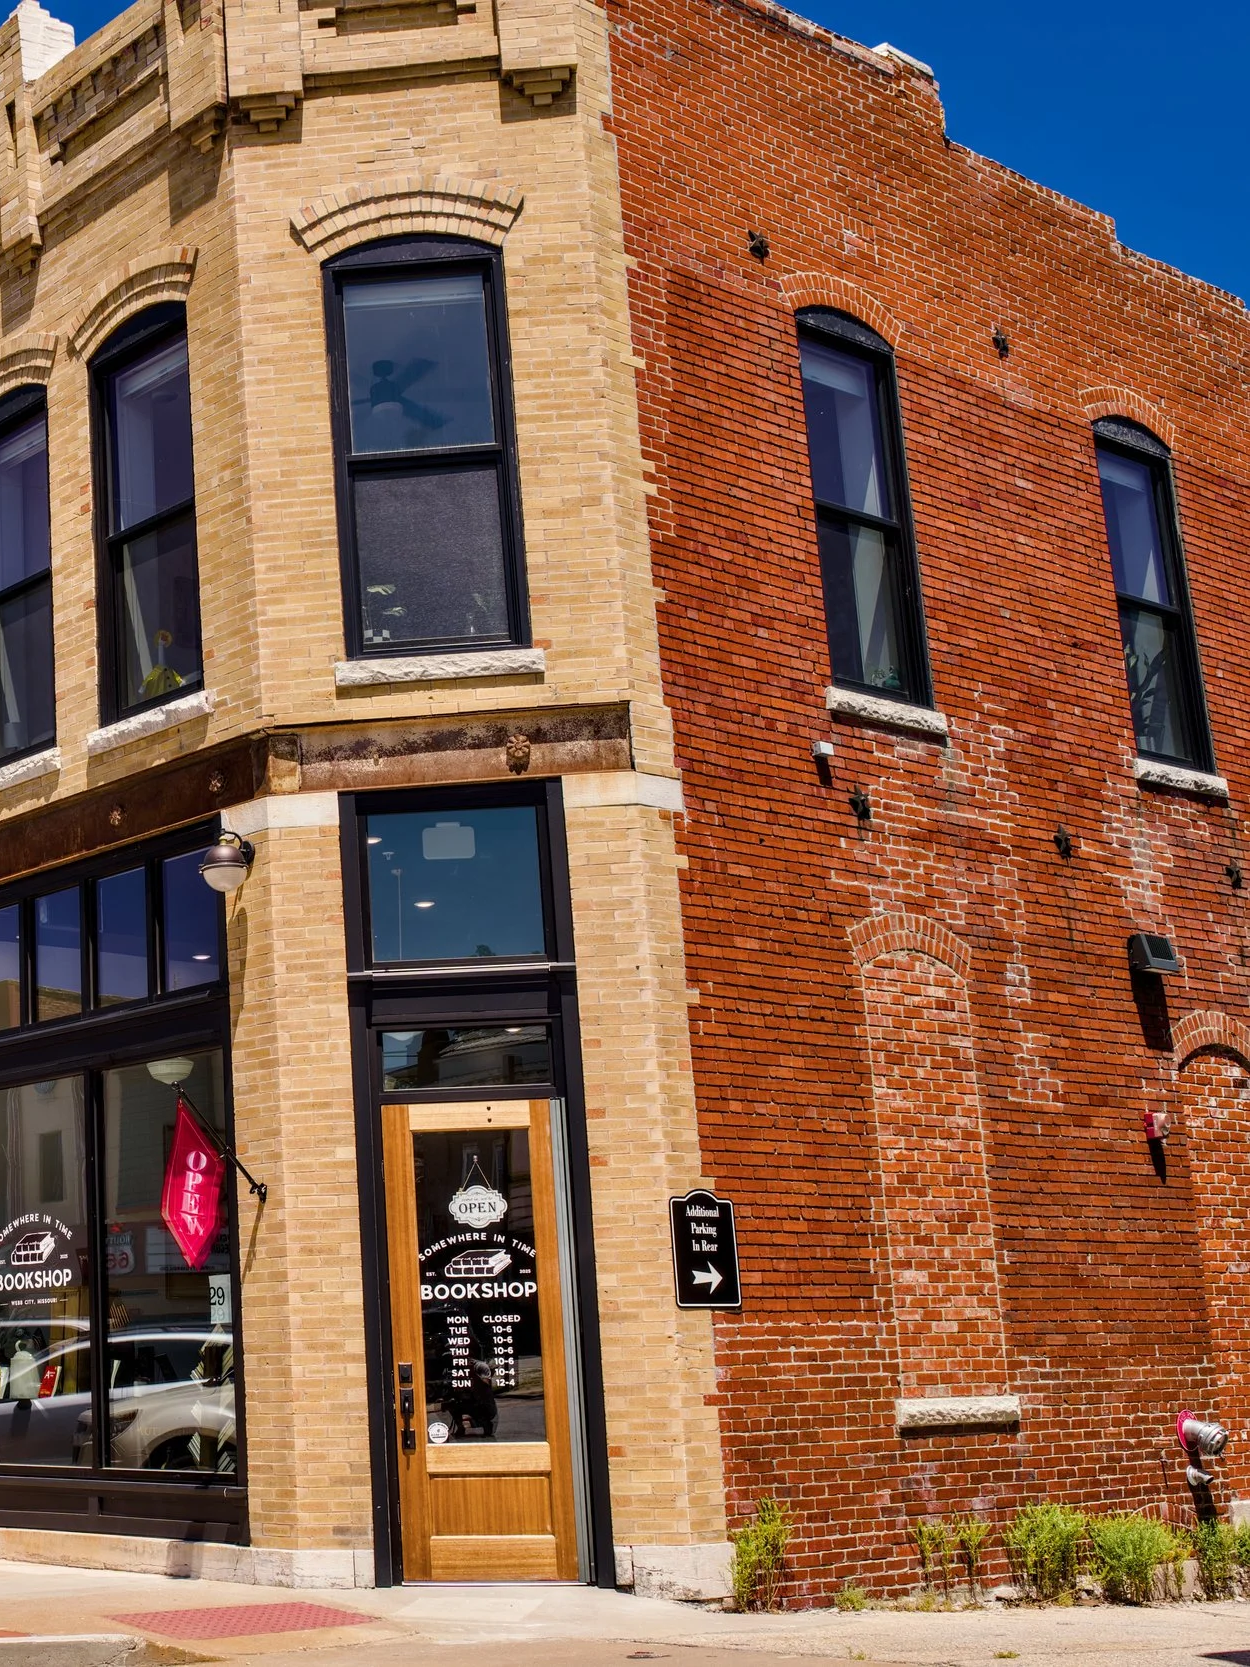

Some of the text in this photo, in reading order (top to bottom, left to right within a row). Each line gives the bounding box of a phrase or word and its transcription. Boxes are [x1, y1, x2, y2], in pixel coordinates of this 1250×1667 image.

[180, 1150, 208, 1236] OPEN
[458, 1202, 497, 1214] OPEN
[685, 1204, 720, 1218] Additional
[42, 1214, 52, 1225] IN
[55, 1219, 73, 1240] TIME
[691, 1222, 717, 1238] Parking
[418, 1232, 536, 1261] SOMEWHERE IN TIME
[692, 1239, 718, 1252] In Rear
[420, 1281, 537, 1301] BOOKSHOP
[447, 1315, 521, 1324] MON CLOSED
[449, 1325, 512, 1335] TUE 10-6
[448, 1336, 513, 1345] WED 10-6
[450, 1347, 513, 1356] THU 10-6
[494, 1357, 514, 1365] 10-6
[452, 1368, 515, 1377] SAT 10-4
[452, 1378, 515, 1388] SUN 12-4
